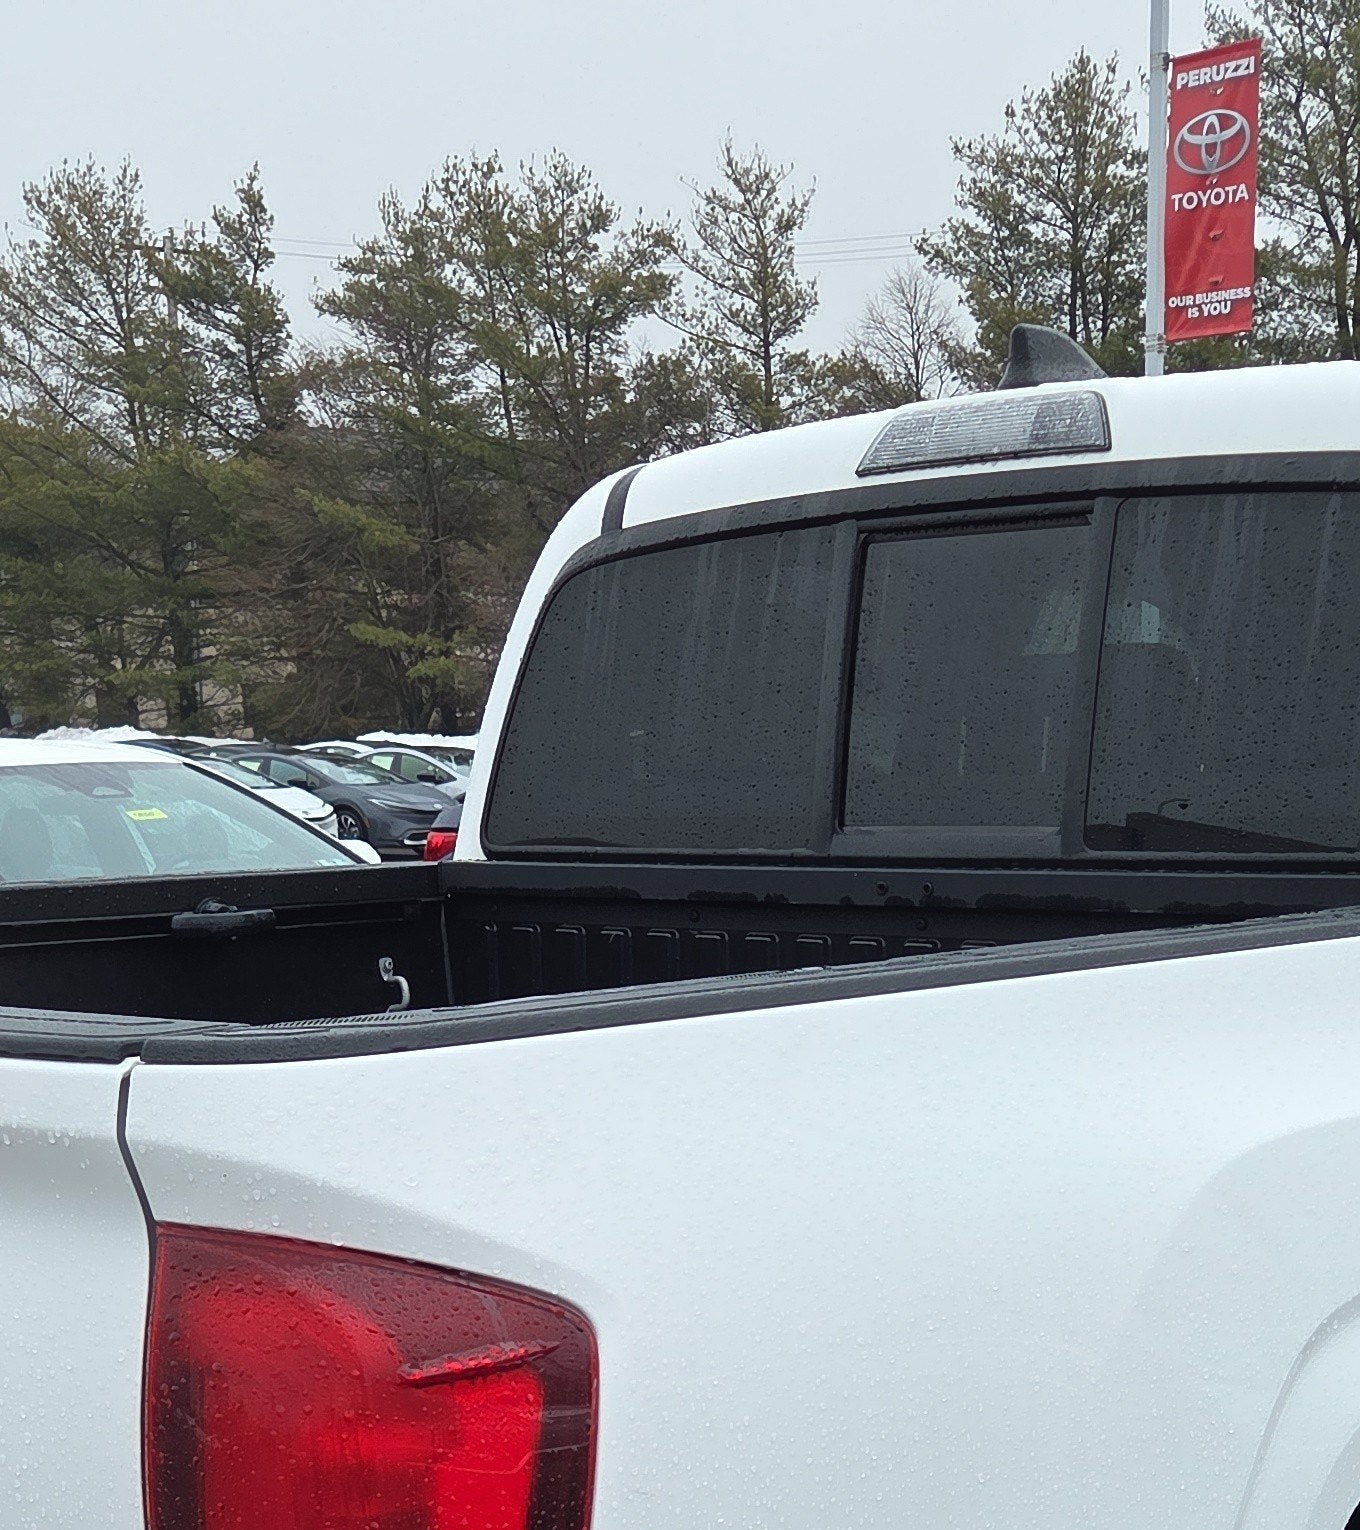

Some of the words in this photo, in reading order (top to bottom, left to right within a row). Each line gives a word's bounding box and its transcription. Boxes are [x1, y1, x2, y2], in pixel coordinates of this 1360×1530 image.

[1176, 55, 1255, 90] PERUZZI
[1171, 183, 1249, 212] TOYOTA
[1168, 295, 1194, 308] OUR
[1195, 286, 1252, 305] BUSINESS
[1187, 307, 1200, 319] IS
[1201, 300, 1232, 317] YOU
